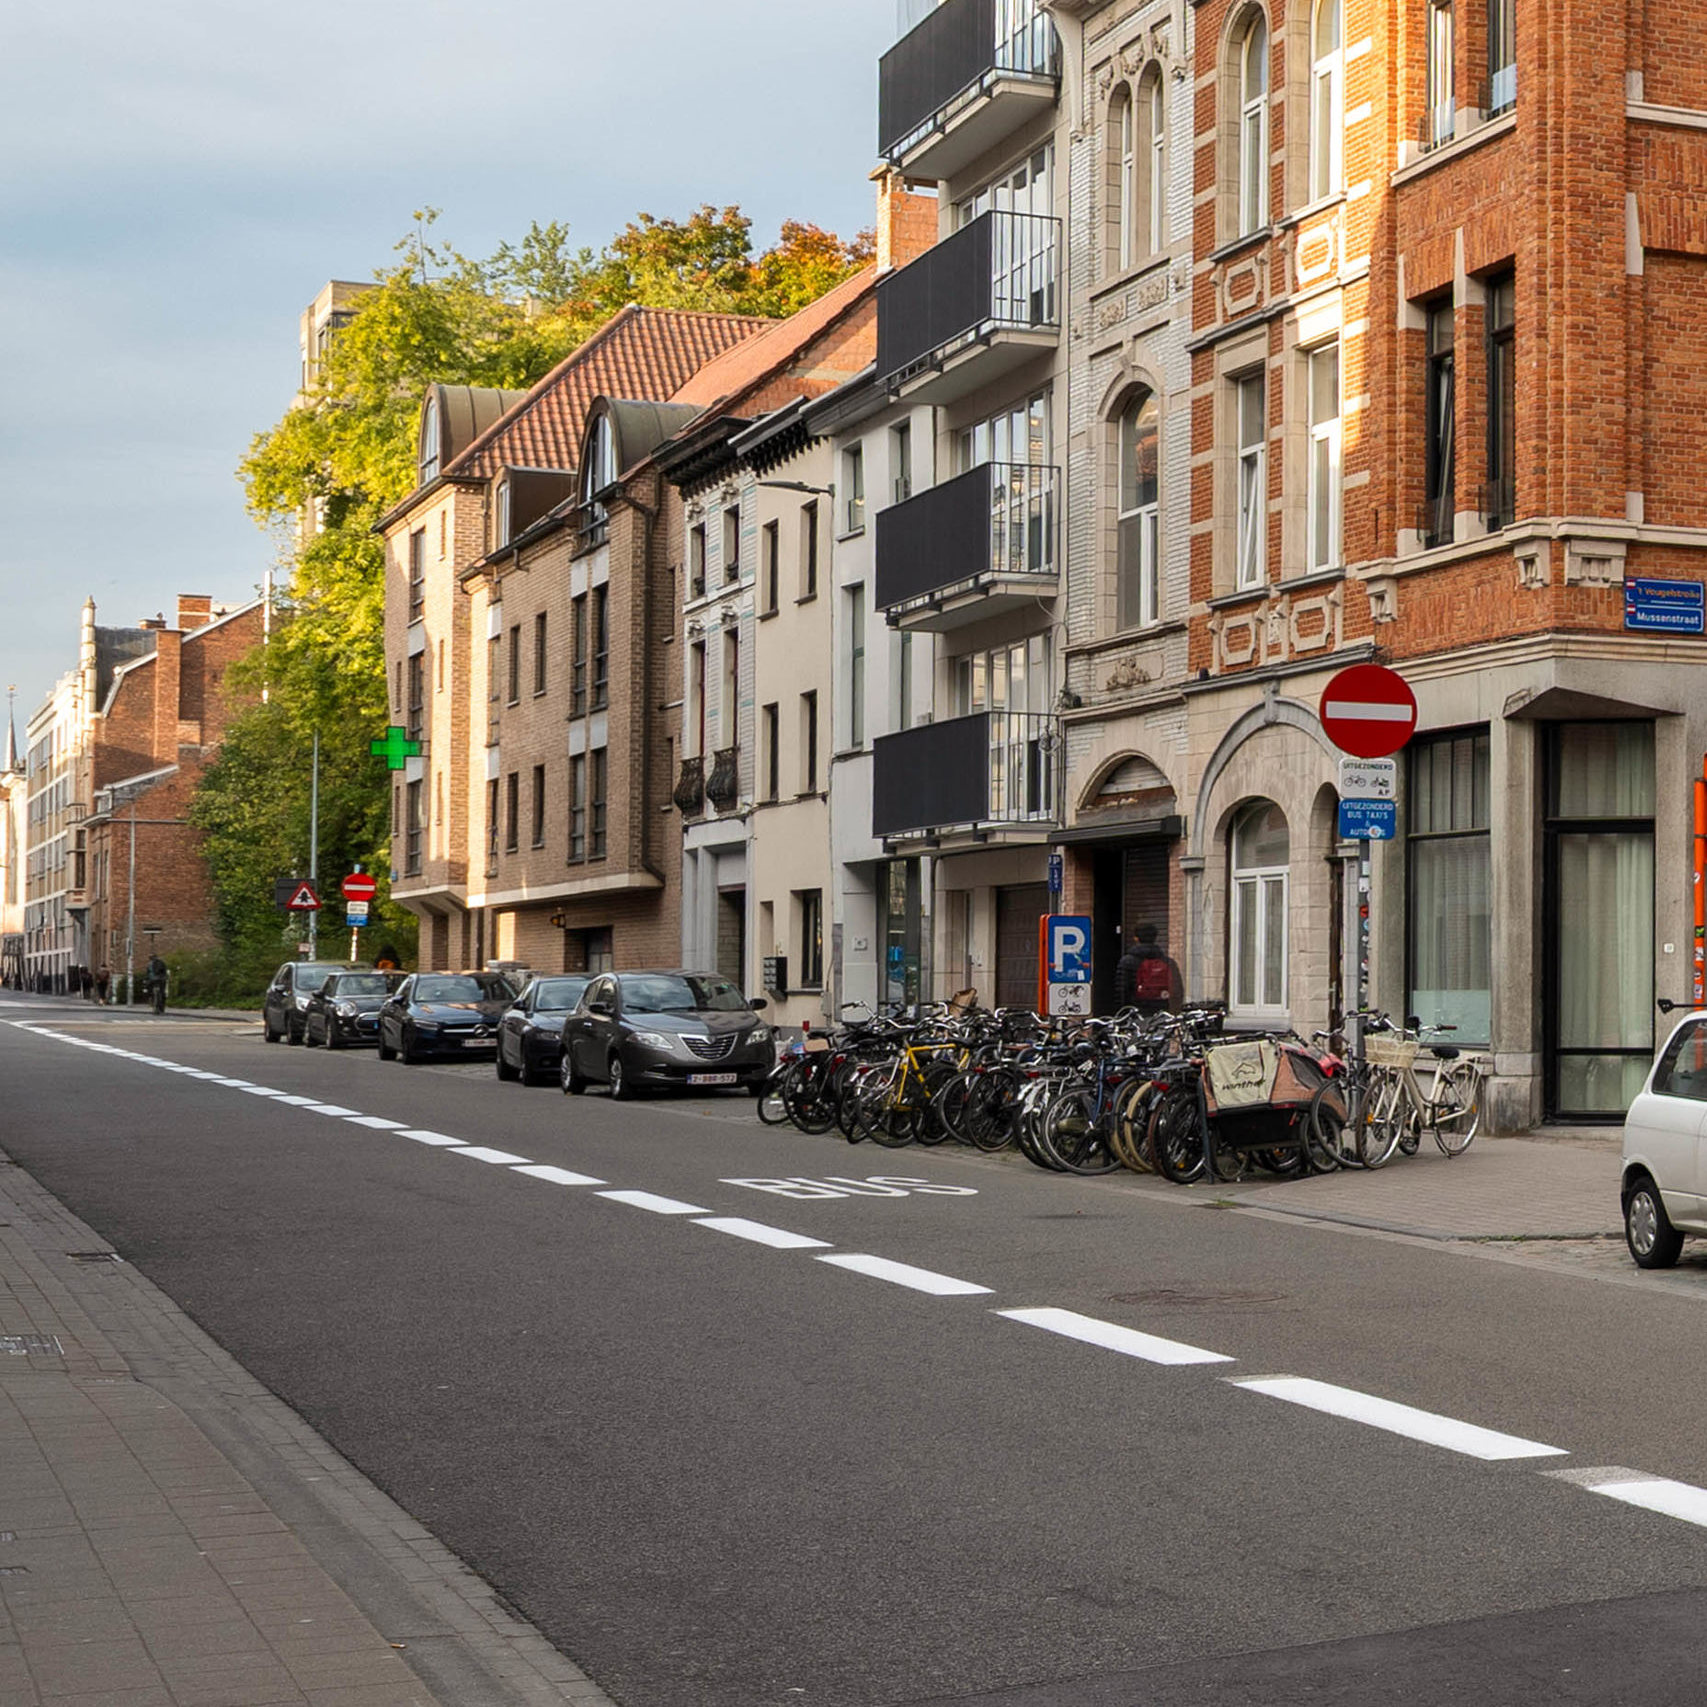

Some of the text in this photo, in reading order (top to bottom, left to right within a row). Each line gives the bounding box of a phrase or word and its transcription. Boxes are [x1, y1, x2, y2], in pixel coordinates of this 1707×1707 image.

[1637, 611, 1700, 625] Mussenstraat
[1343, 762, 1394, 771] UITGEZONDERD
[1342, 802, 1394, 811] UITGEZONDERD
[1347, 811, 1362, 819] BUS
[1054, 926, 1086, 973] P
[718, 1176, 979, 1199] BUS
